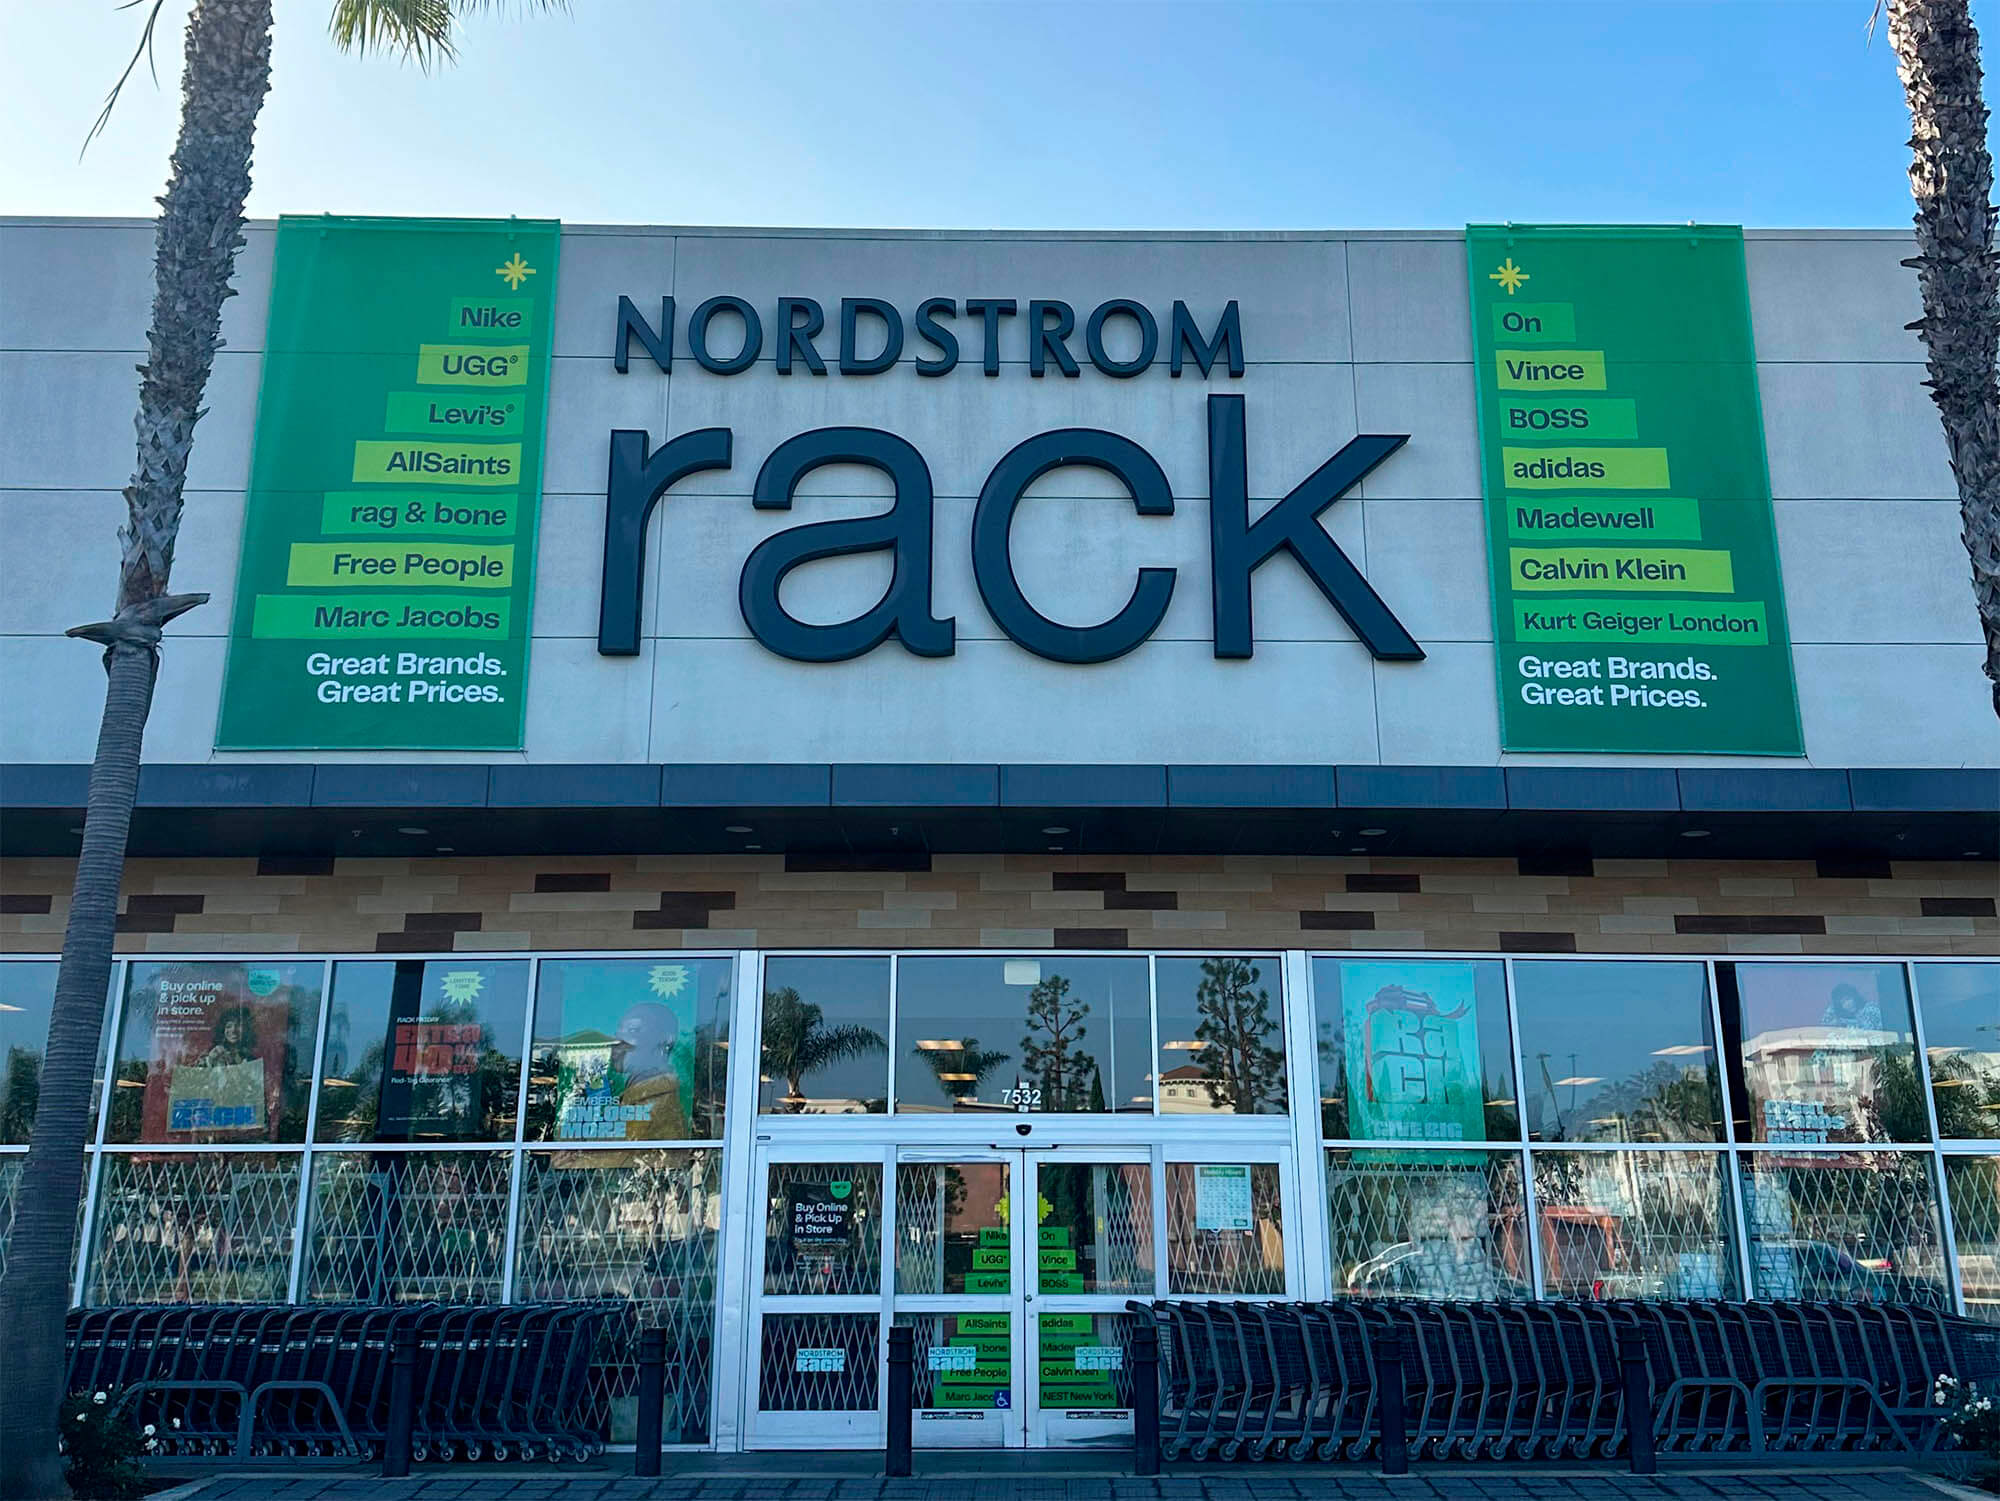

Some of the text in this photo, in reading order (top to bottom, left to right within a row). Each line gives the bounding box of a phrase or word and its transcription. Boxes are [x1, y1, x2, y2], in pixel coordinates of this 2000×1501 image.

[460, 307, 522, 328] Nike
[1502, 312, 1542, 334] On
[614, 295, 1245, 380] NORDSTROM
[1505, 359, 1584, 381] Vince
[1509, 408, 1589, 430] BOSS
[386, 451, 511, 475] AllSaints
[1512, 457, 1605, 480] adidas
[350, 502, 507, 529] rag & bone
[1516, 506, 1655, 530] Madewell
[597, 393, 1427, 665] rack
[333, 553, 504, 582] Free People
[1519, 558, 1687, 582] Calvin Klein
[314, 606, 500, 630] Marc Jacobs
[1523, 612, 1759, 636] Kurt Geiger London
[306, 652, 507, 675] Great Brands.
[1518, 655, 1718, 681] Great Brands.
[317, 680, 504, 703] Great Prices.
[1521, 683, 1708, 709] Great Prices.
[160, 980, 223, 993] Buy online
[159, 992, 216, 1005] & pick up
[157, 1005, 204, 1016] in store.
[1002, 1089, 1042, 1105] 7532
[795, 1202, 848, 1214] Buy Online
[795, 1213, 843, 1224] & Pick Up
[794, 1224, 833, 1234] in Store
[986, 1231, 1007, 1241] Nike
[1041, 1232, 1055, 1241] On
[1042, 1255, 1068, 1265] Vince
[1042, 1279, 1068, 1288] BOSS
[965, 1319, 1007, 1329] AllSaints
[1042, 1319, 1074, 1328] adidas
[799, 1350, 843, 1358] NORDSTROM
[982, 1344, 1007, 1353] bone
[950, 1368, 1007, 1379] Free People
[1043, 1367, 1073, 1377] Calvin
[945, 1392, 995, 1401] Marc Jaco
[1043, 1391, 1114, 1401] NEST New York
